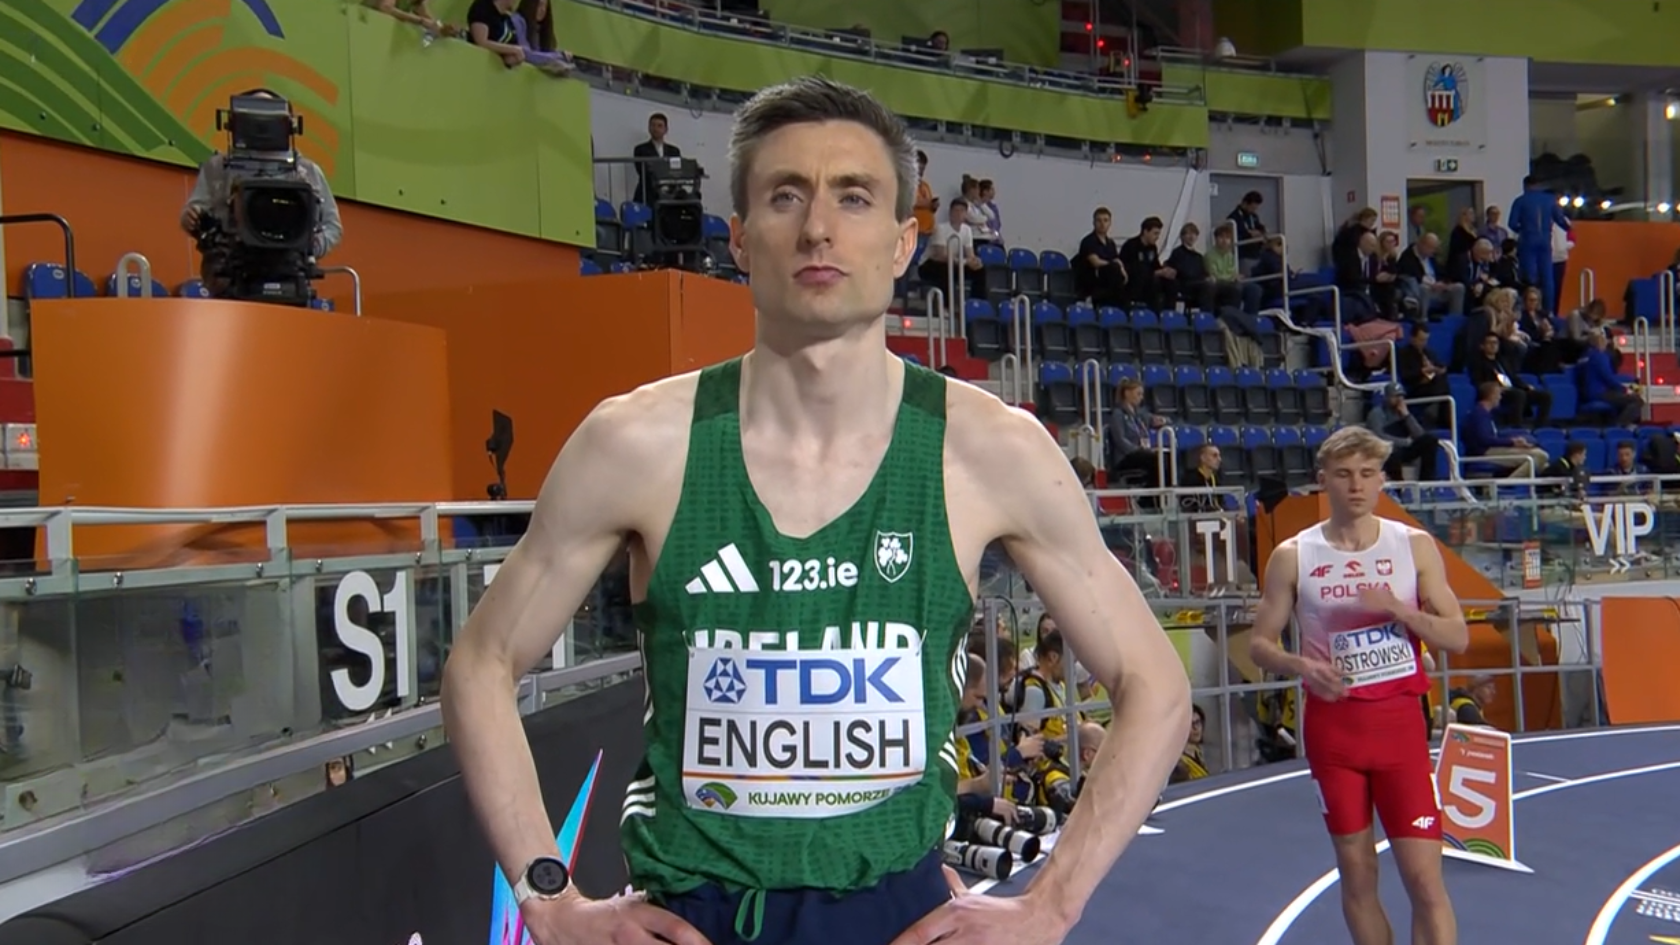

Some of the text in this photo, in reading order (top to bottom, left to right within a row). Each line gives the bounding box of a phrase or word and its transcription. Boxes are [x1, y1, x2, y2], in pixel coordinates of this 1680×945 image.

[1196, 519, 1234, 583] T1
[1582, 502, 1654, 556] VIP
[769, 557, 858, 591] 123.ie
[330, 570, 409, 711] S1
[1335, 642, 1412, 672] OSTROWSKI
[1347, 622, 1402, 648] TDK
[746, 657, 905, 705] TDK
[698, 717, 910, 769] ENGLISH
[748, 792, 811, 806] KUJAWY
[1444, 765, 1496, 829] 5
[1412, 816, 1435, 829] 4F
